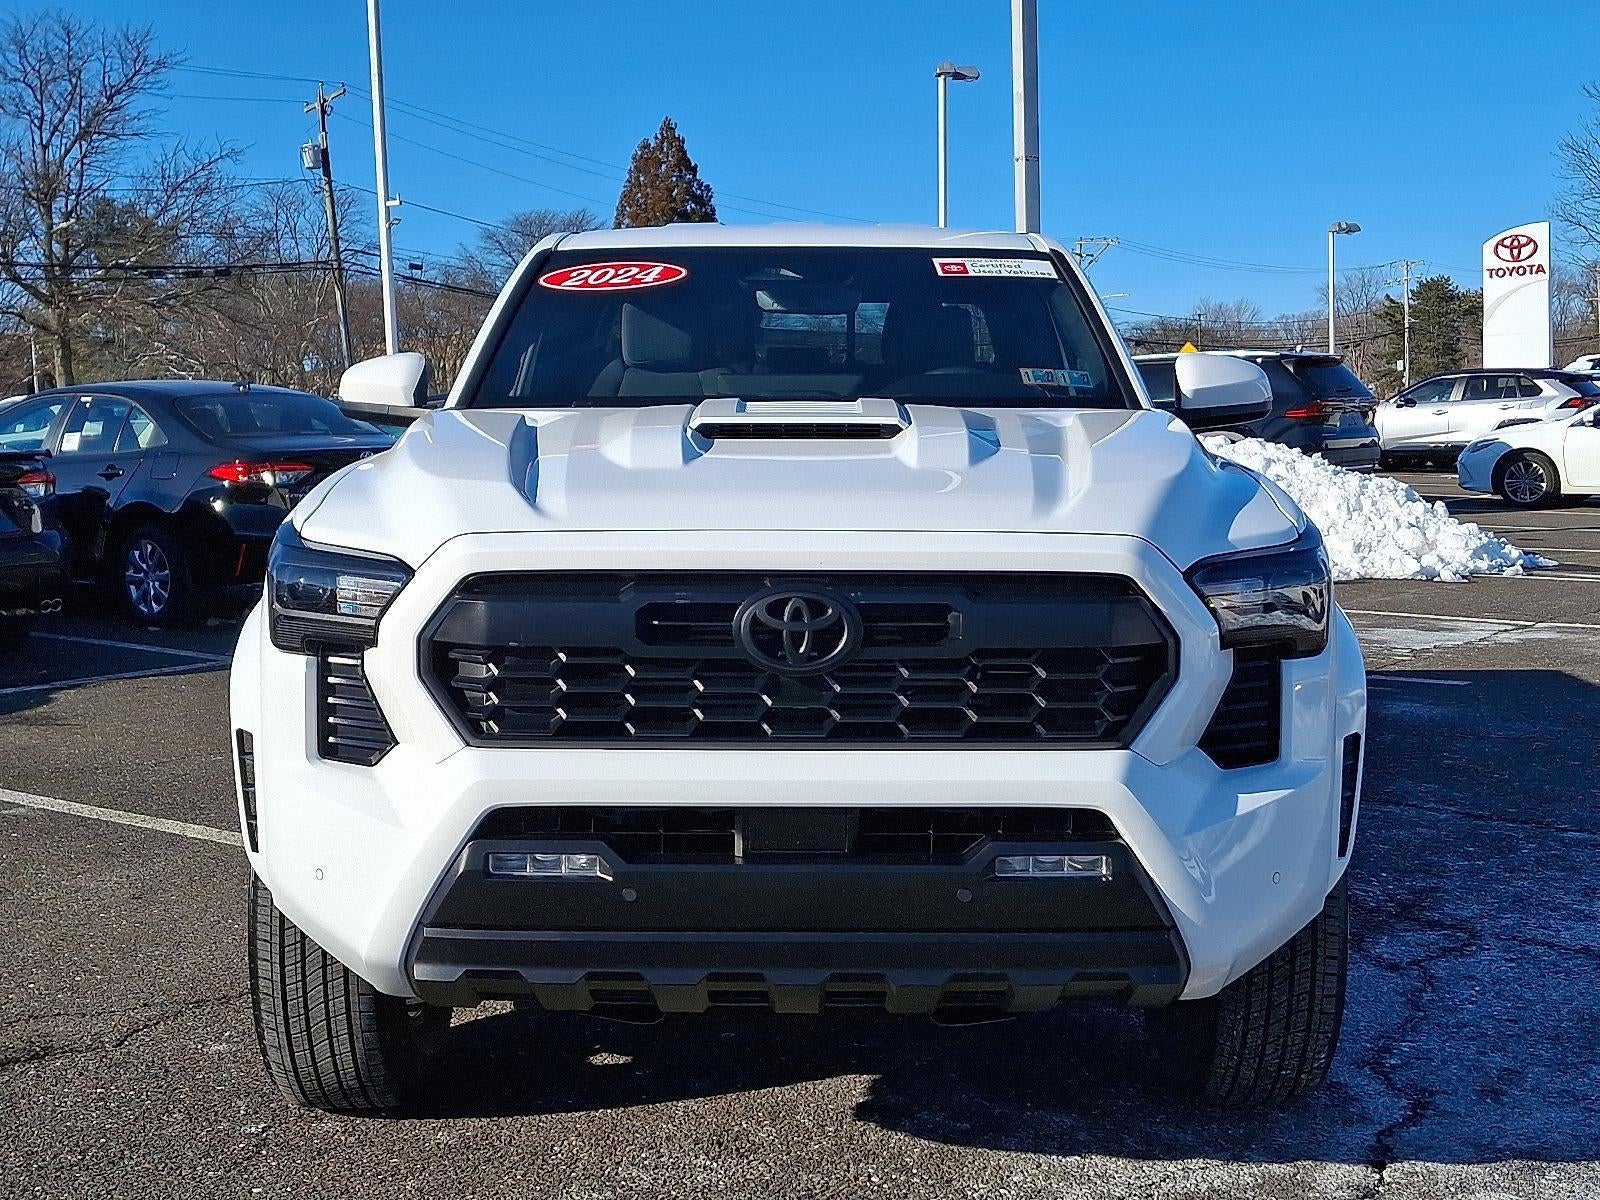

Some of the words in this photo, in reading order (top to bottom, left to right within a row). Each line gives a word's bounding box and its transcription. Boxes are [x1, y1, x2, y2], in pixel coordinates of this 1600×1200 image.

[561, 265, 665, 287] 2024
[1004, 269, 1053, 277] Vehicles
[1486, 264, 1546, 279] TOYOTA
